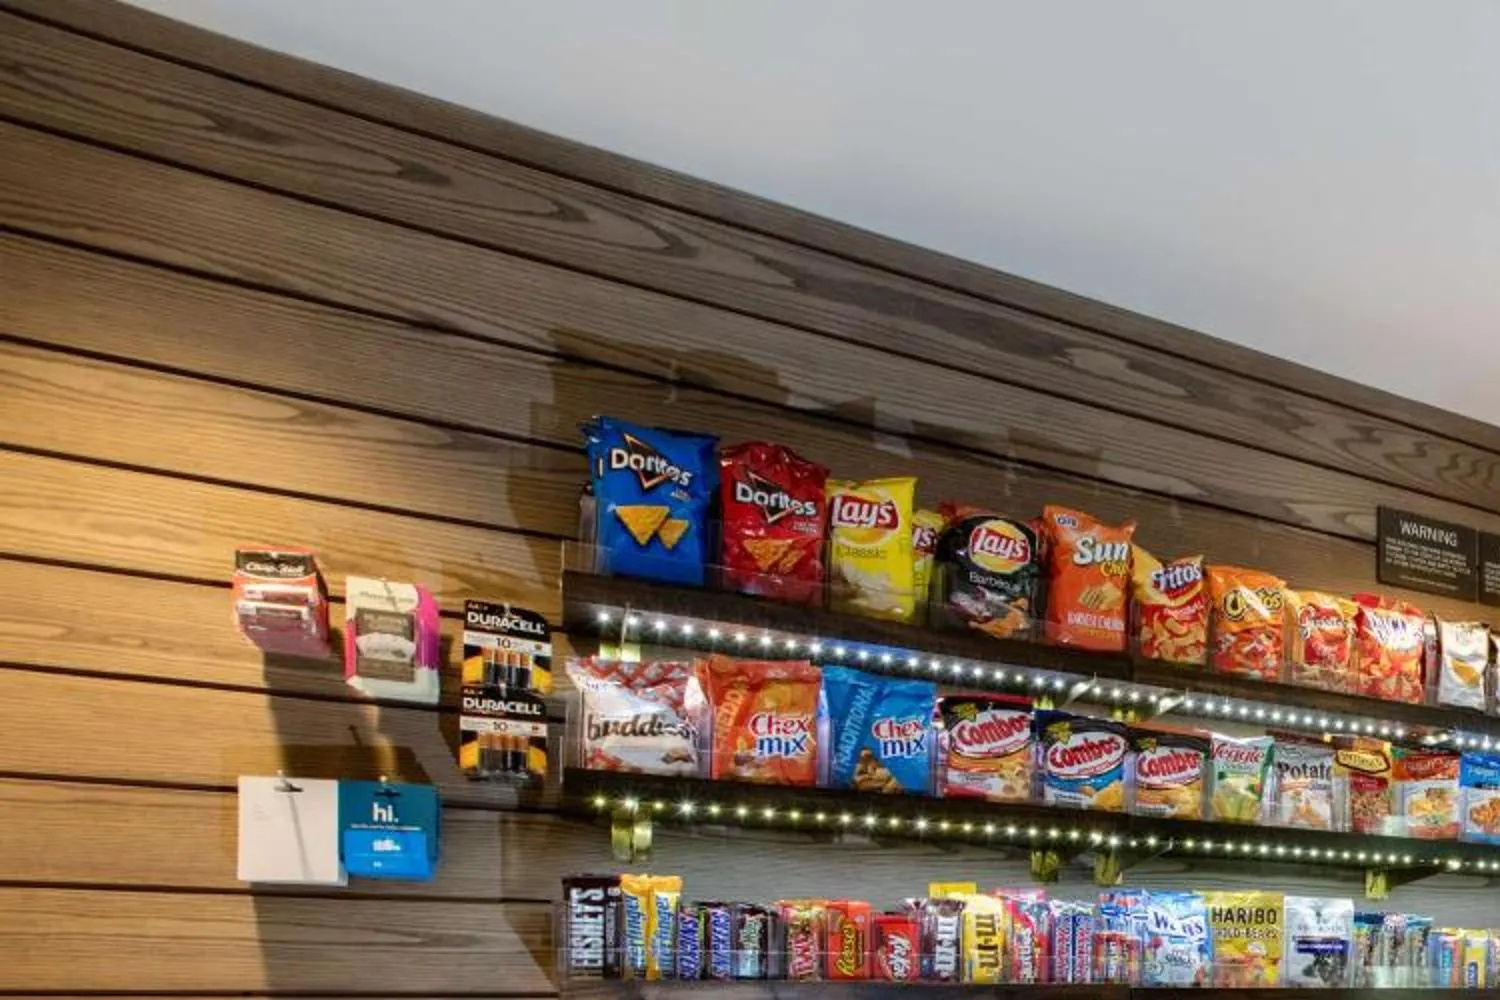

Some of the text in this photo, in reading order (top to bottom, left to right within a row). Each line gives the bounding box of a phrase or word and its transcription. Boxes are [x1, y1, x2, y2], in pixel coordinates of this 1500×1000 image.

[611, 448, 693, 486] Doritos
[735, 481, 817, 516] Doritos
[1400, 520, 1458, 547] WARNING
[1073, 536, 1130, 565] Sun
[1151, 563, 1201, 591] Fritos
[467, 611, 546, 634] DURACELL
[496, 637, 511, 649] 10
[463, 697, 541, 715] DURACELL
[751, 712, 808, 737] Chex
[873, 717, 926, 740] Chex
[957, 711, 1030, 745] Combos
[757, 733, 807, 757] mix
[882, 735, 926, 757] mix
[1049, 735, 1122, 770] Combos
[1212, 742, 1265, 763] Veggie
[372, 802, 399, 823] hi.
[1211, 906, 1278, 924] HARIBO
